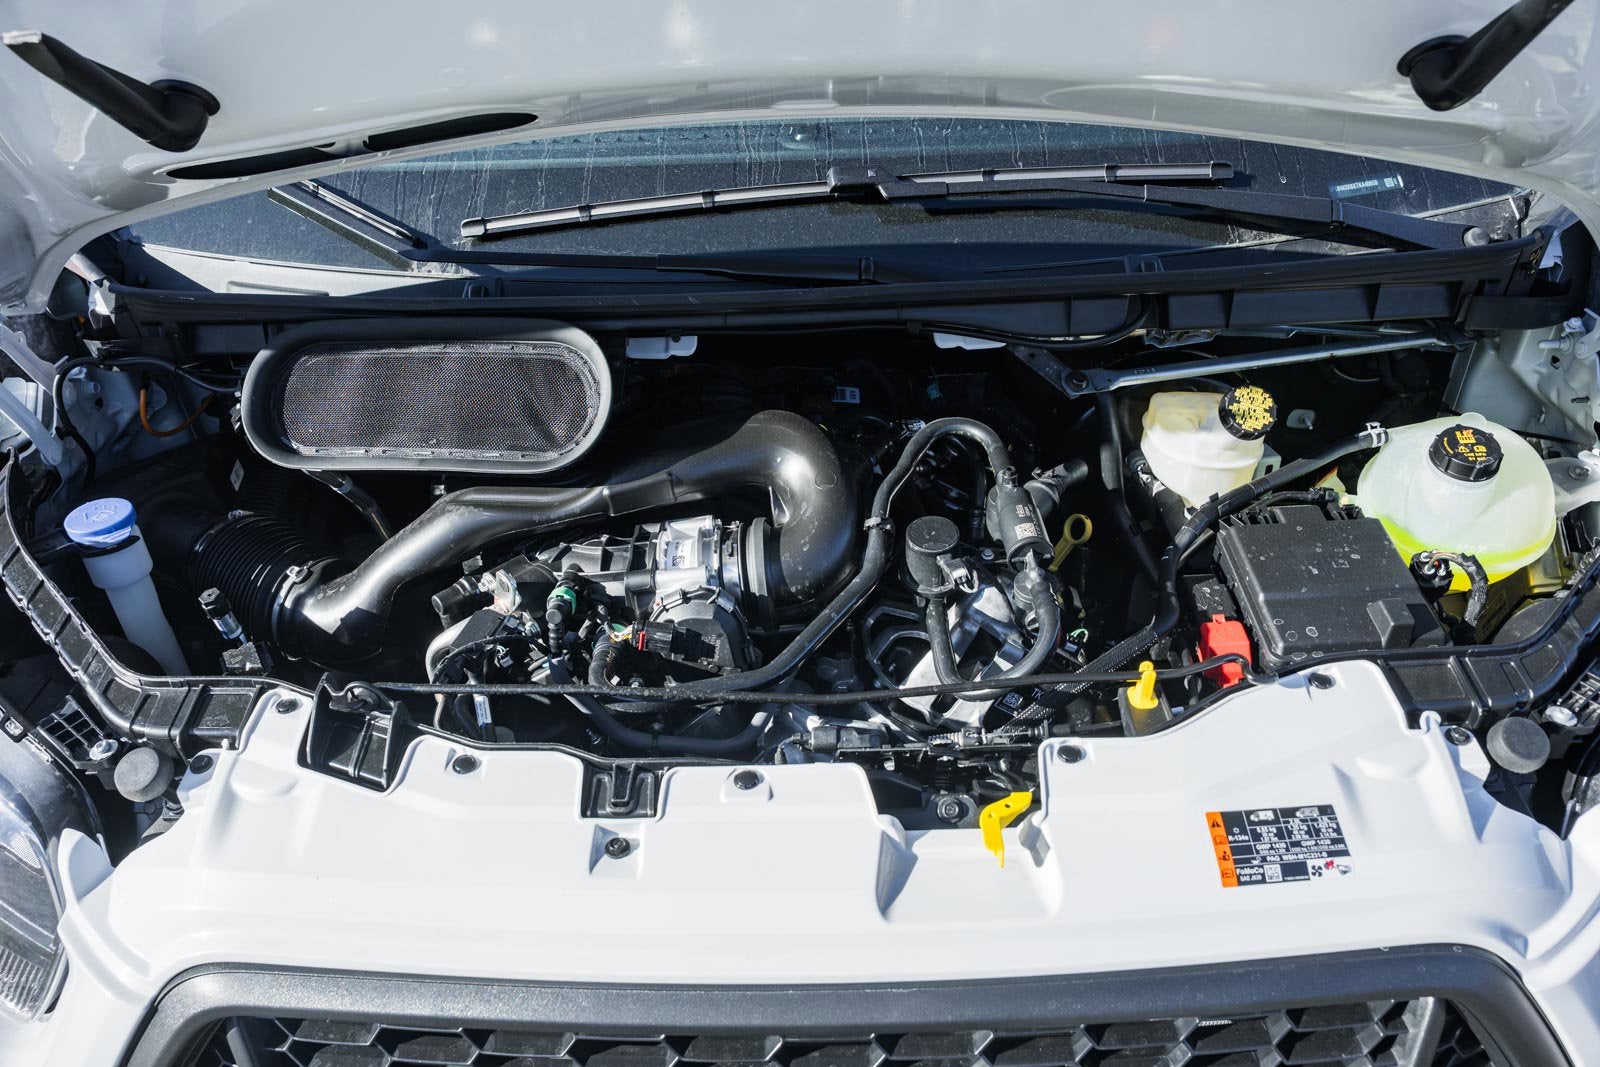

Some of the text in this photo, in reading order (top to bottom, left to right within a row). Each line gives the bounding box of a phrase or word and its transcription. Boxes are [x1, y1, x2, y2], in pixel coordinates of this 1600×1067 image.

[1031, 687, 1046, 700] TK
[1228, 834, 1249, 842] R-134a
[1256, 842, 1271, 850] GWP
[1300, 839, 1316, 847] GWP
[1236, 867, 1264, 876] FoMoCo
